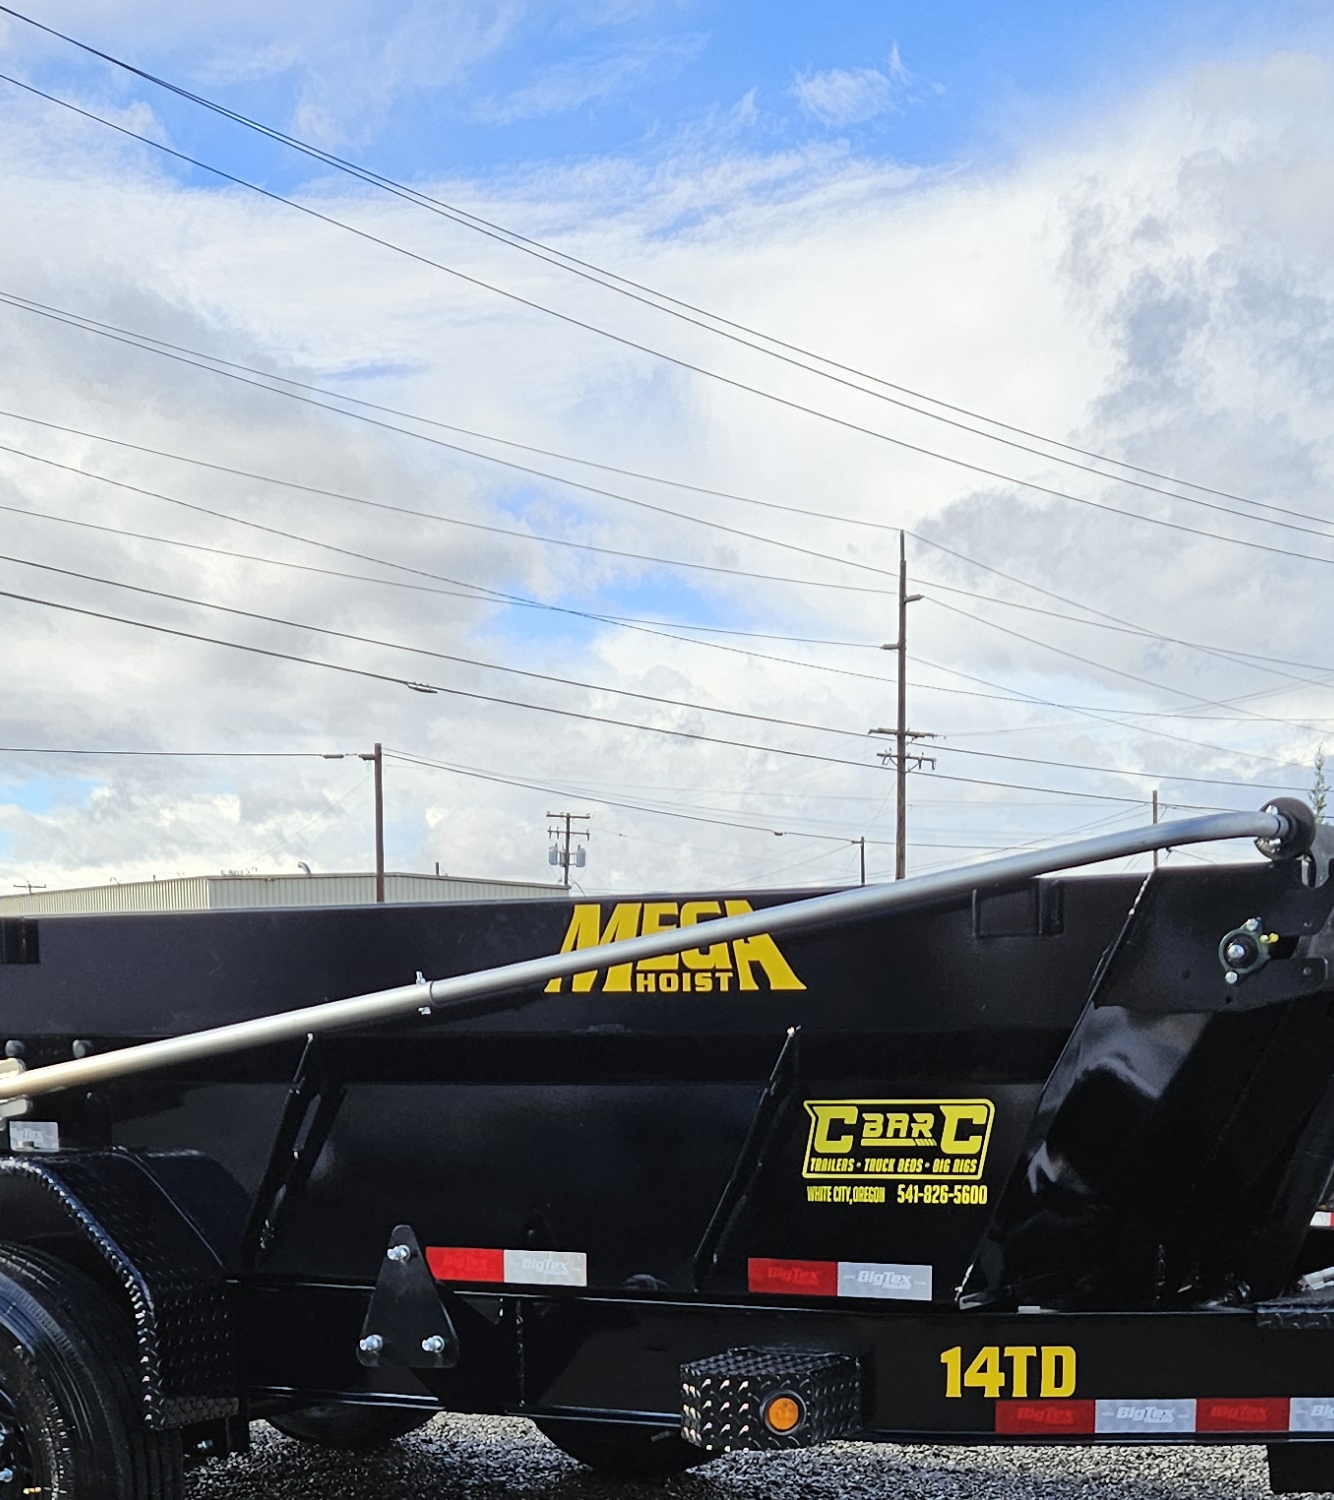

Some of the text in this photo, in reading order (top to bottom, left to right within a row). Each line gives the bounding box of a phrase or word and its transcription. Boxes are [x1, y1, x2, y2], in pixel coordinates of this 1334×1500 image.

[544, 899, 807, 993] MEGA
[636, 972, 733, 992] HOIST
[813, 1105, 988, 1154] C BAR C
[810, 1157, 977, 1173] TRAILERS TRUCK BEDS BIG RIGS
[807, 1185, 832, 1202] WHITE
[897, 1184, 988, 1205] 541-826-5600
[857, 1270, 912, 1287] BigTex
[940, 1346, 1076, 1397] 14TD
